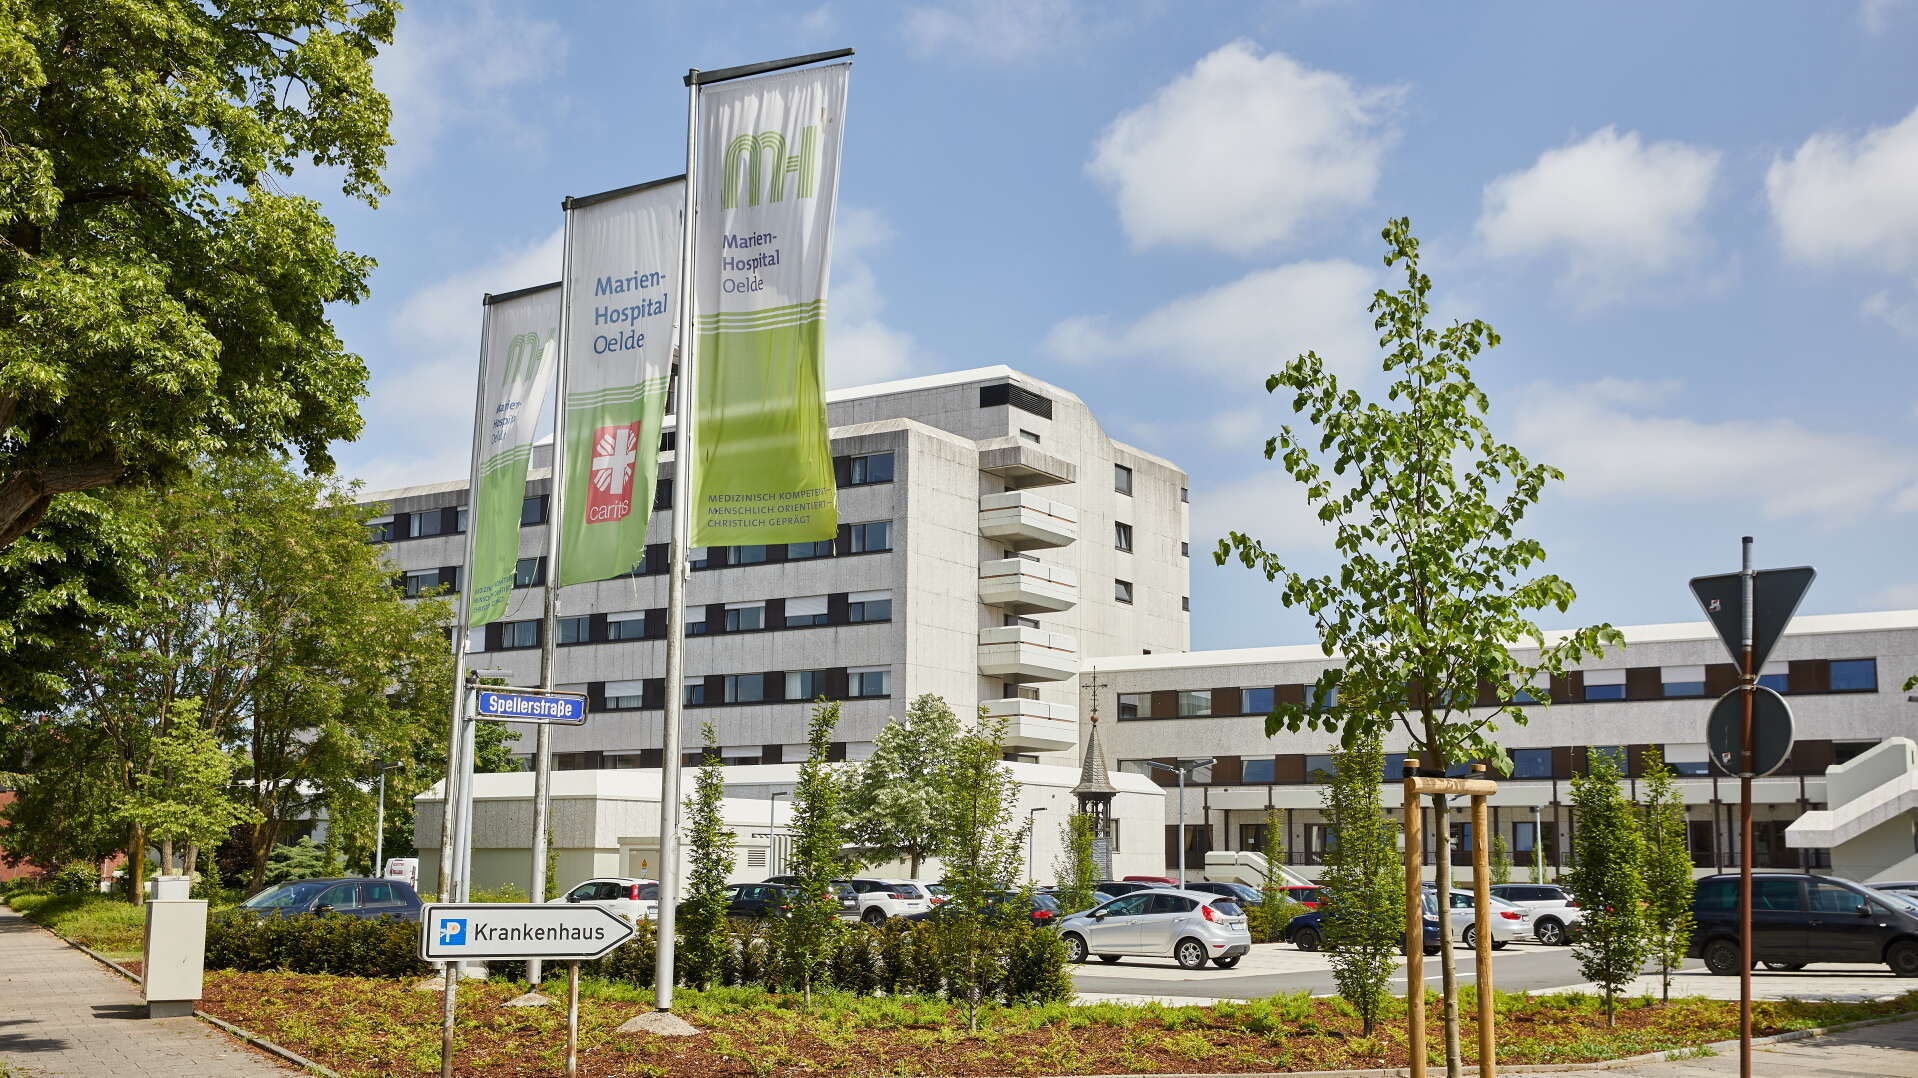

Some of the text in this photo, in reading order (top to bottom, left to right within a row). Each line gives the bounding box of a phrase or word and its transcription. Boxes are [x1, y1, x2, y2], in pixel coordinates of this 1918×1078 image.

[722, 231, 777, 249] Marien-
[722, 249, 780, 274] Hospital
[594, 270, 666, 297] Marien-
[722, 275, 764, 293] Oelde
[594, 292, 668, 327] Hospital
[593, 329, 645, 354] Oelde
[708, 493, 776, 503] MEDIZINISCH
[708, 506, 774, 515] MENSCHLICH
[777, 500, 826, 513] ORIENTIERT
[707, 514, 810, 528] CHRISTLICH GEPRÄGT
[489, 695, 572, 717] Spellerstraße
[474, 923, 605, 941] Krankenhaus
